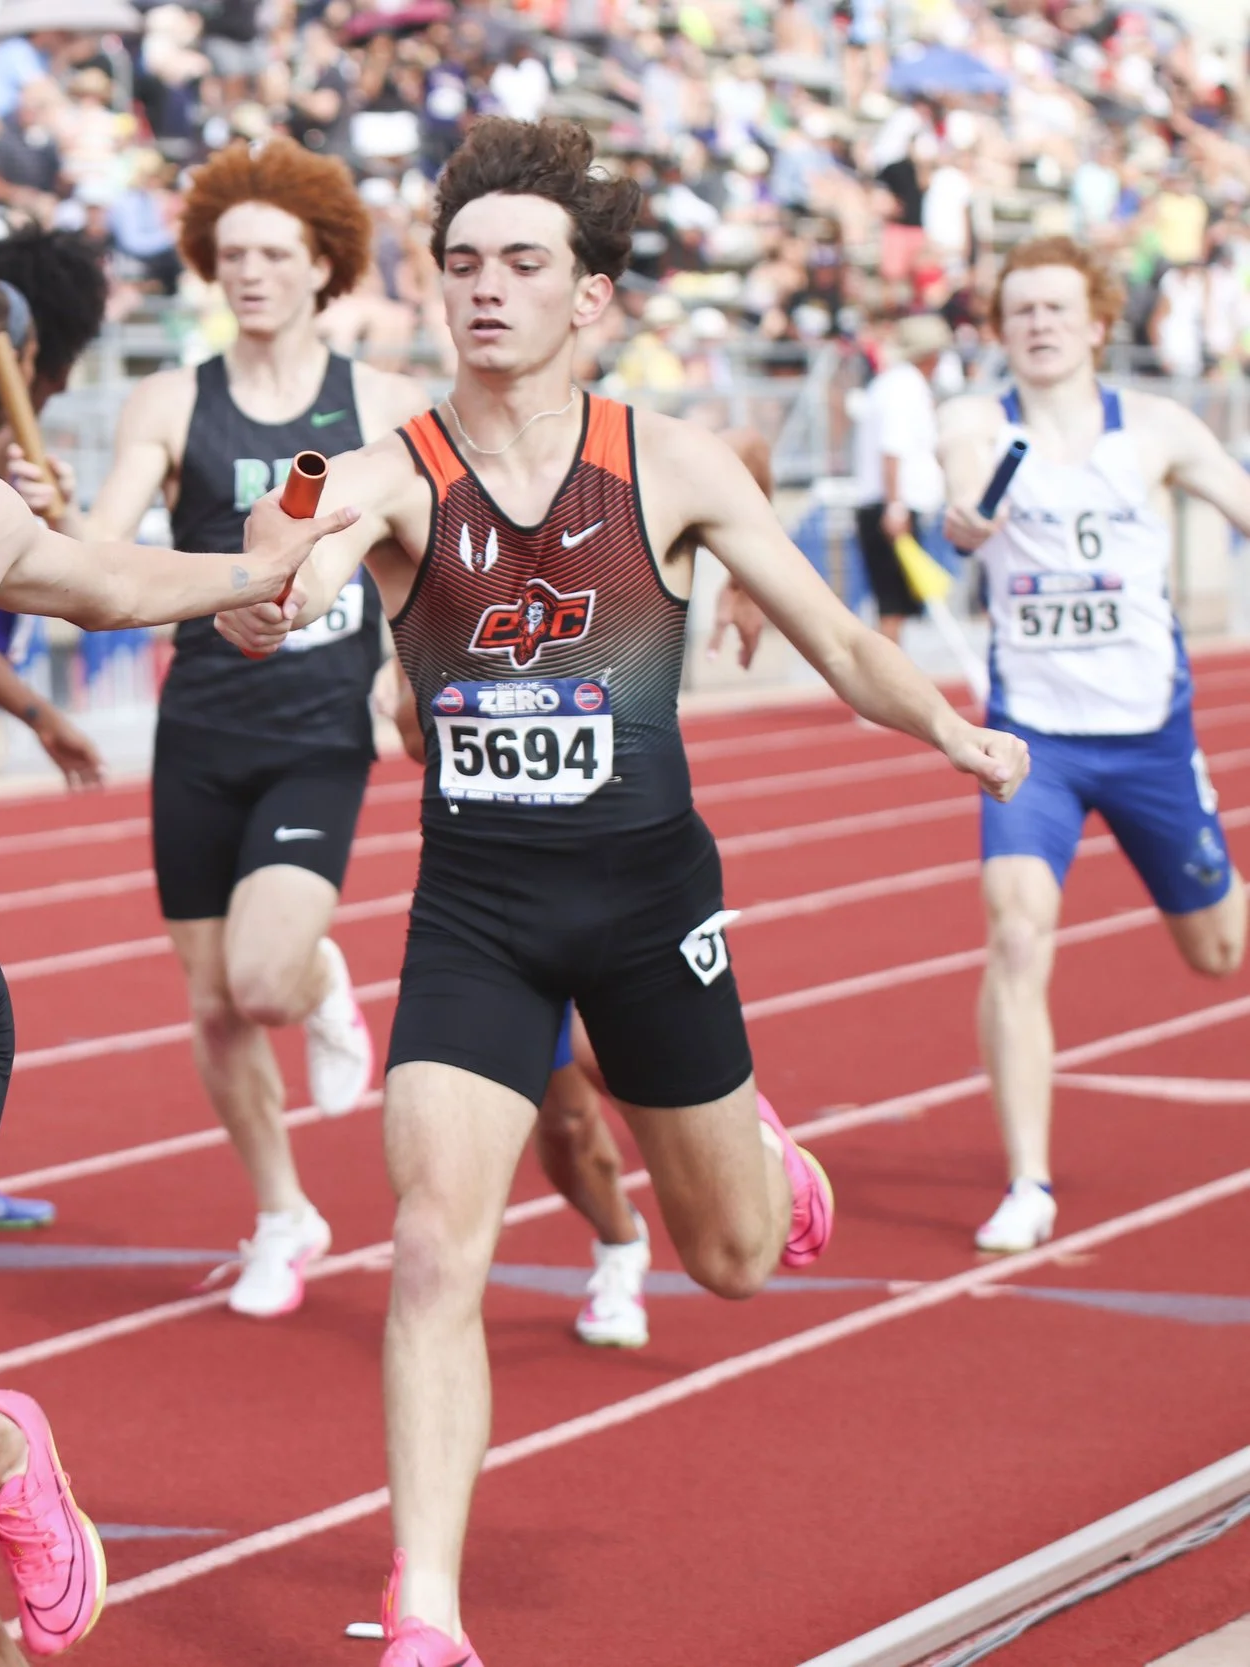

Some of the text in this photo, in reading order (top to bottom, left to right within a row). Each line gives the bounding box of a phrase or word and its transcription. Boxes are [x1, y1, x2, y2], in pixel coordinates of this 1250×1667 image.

[1076, 511, 1102, 560] 6
[1019, 601, 1120, 637] 5793
[476, 688, 561, 712] ZERO
[450, 724, 599, 781] 5694
